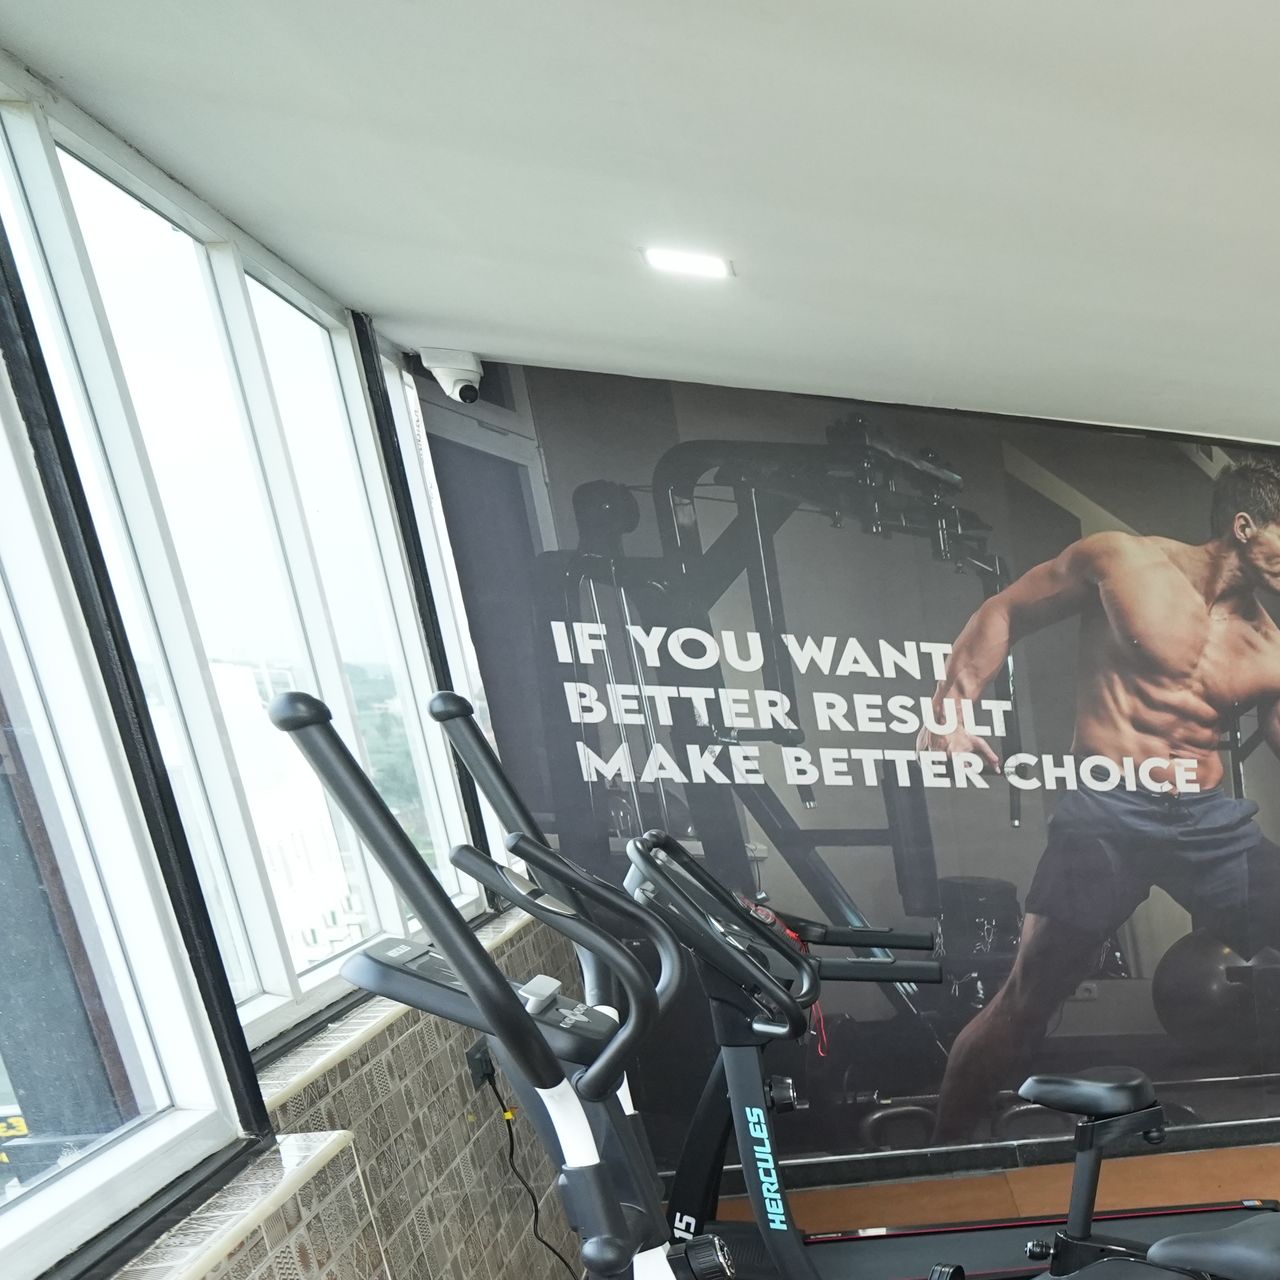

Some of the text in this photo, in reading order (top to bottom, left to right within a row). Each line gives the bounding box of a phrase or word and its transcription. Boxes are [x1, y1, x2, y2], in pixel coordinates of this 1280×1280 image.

[550, 621, 953, 681] IF YOU WANT
[563, 681, 1013, 737] BETTER RESULT
[575, 741, 1200, 794] MAKE BETTER CHOICE
[745, 1106, 788, 1230] HERCULES
